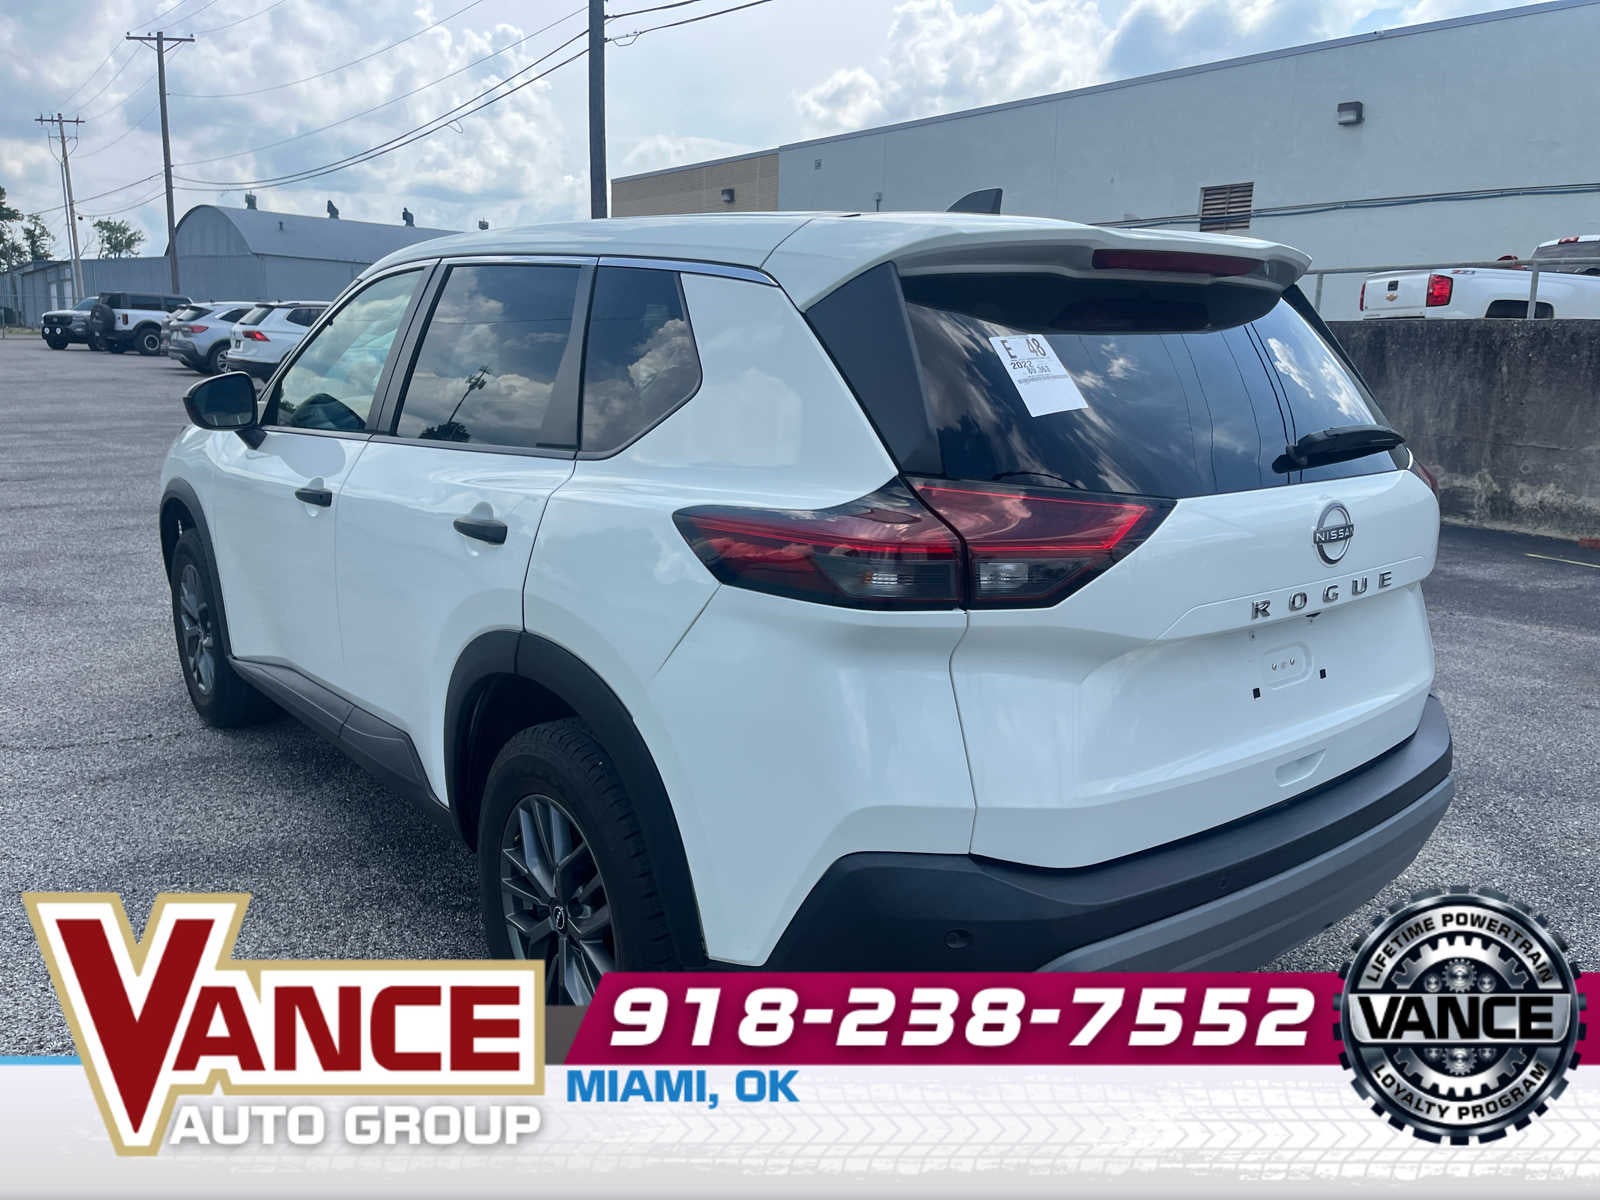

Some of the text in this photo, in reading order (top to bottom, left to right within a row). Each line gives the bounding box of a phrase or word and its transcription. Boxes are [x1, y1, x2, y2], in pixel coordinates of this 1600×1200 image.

[1001, 337, 1047, 359] E 48
[1251, 570, 1393, 620] ROGUE
